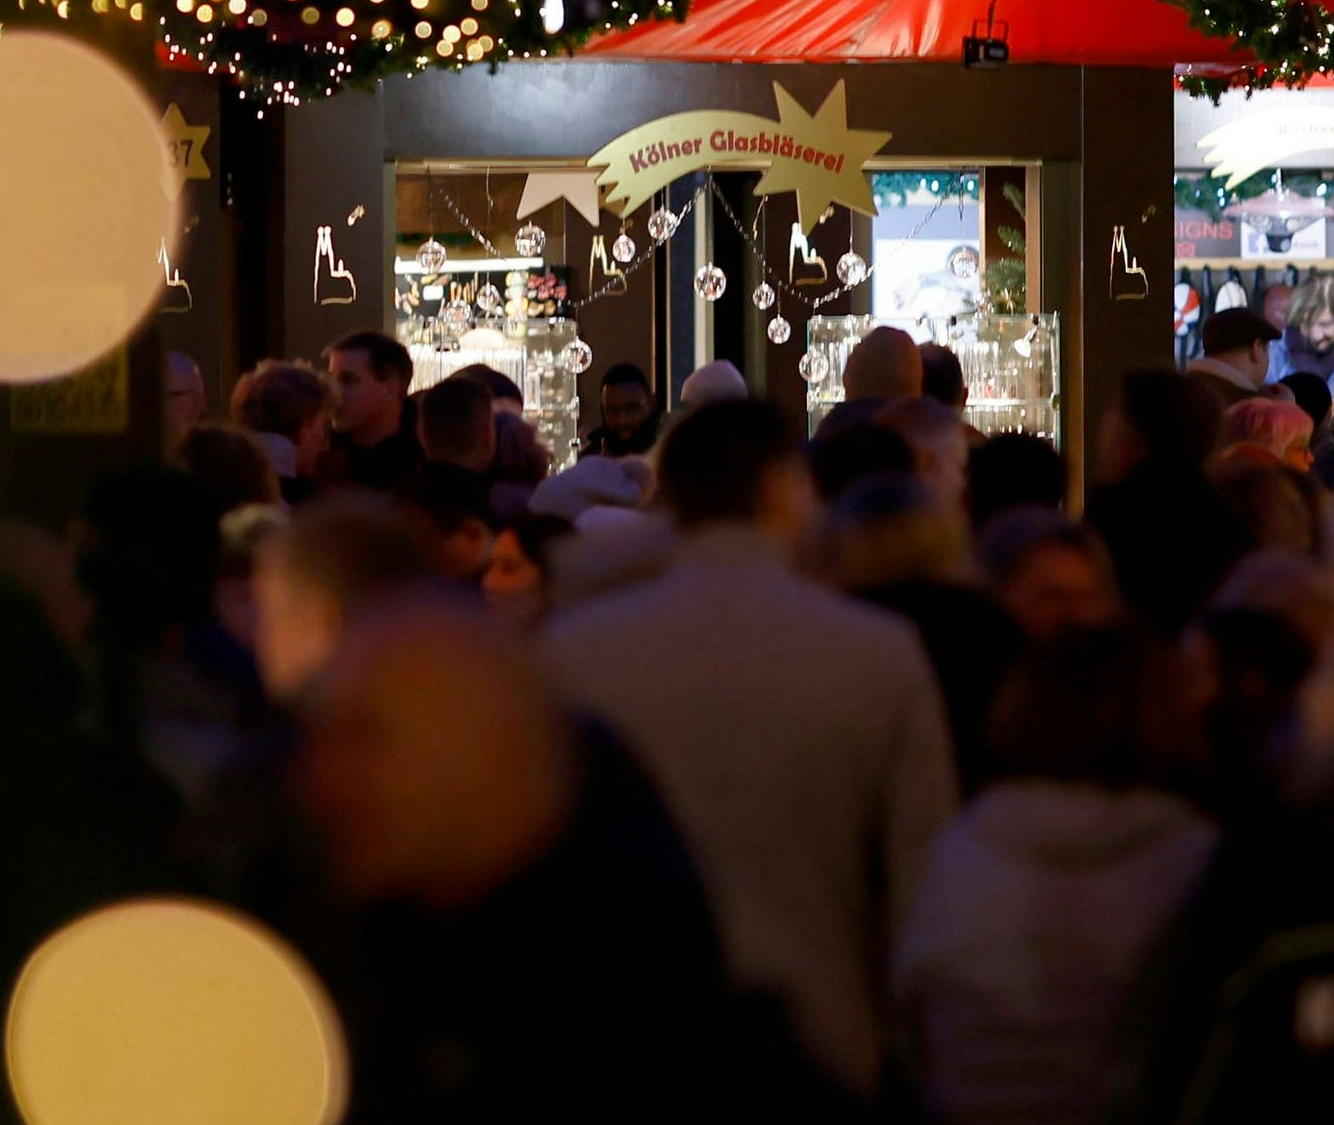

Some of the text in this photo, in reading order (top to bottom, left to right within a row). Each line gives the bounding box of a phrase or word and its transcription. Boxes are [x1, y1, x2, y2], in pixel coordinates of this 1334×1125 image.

[629, 130, 845, 174] Kölner Glasbläserei
[1175, 220, 1234, 240] IGNS
